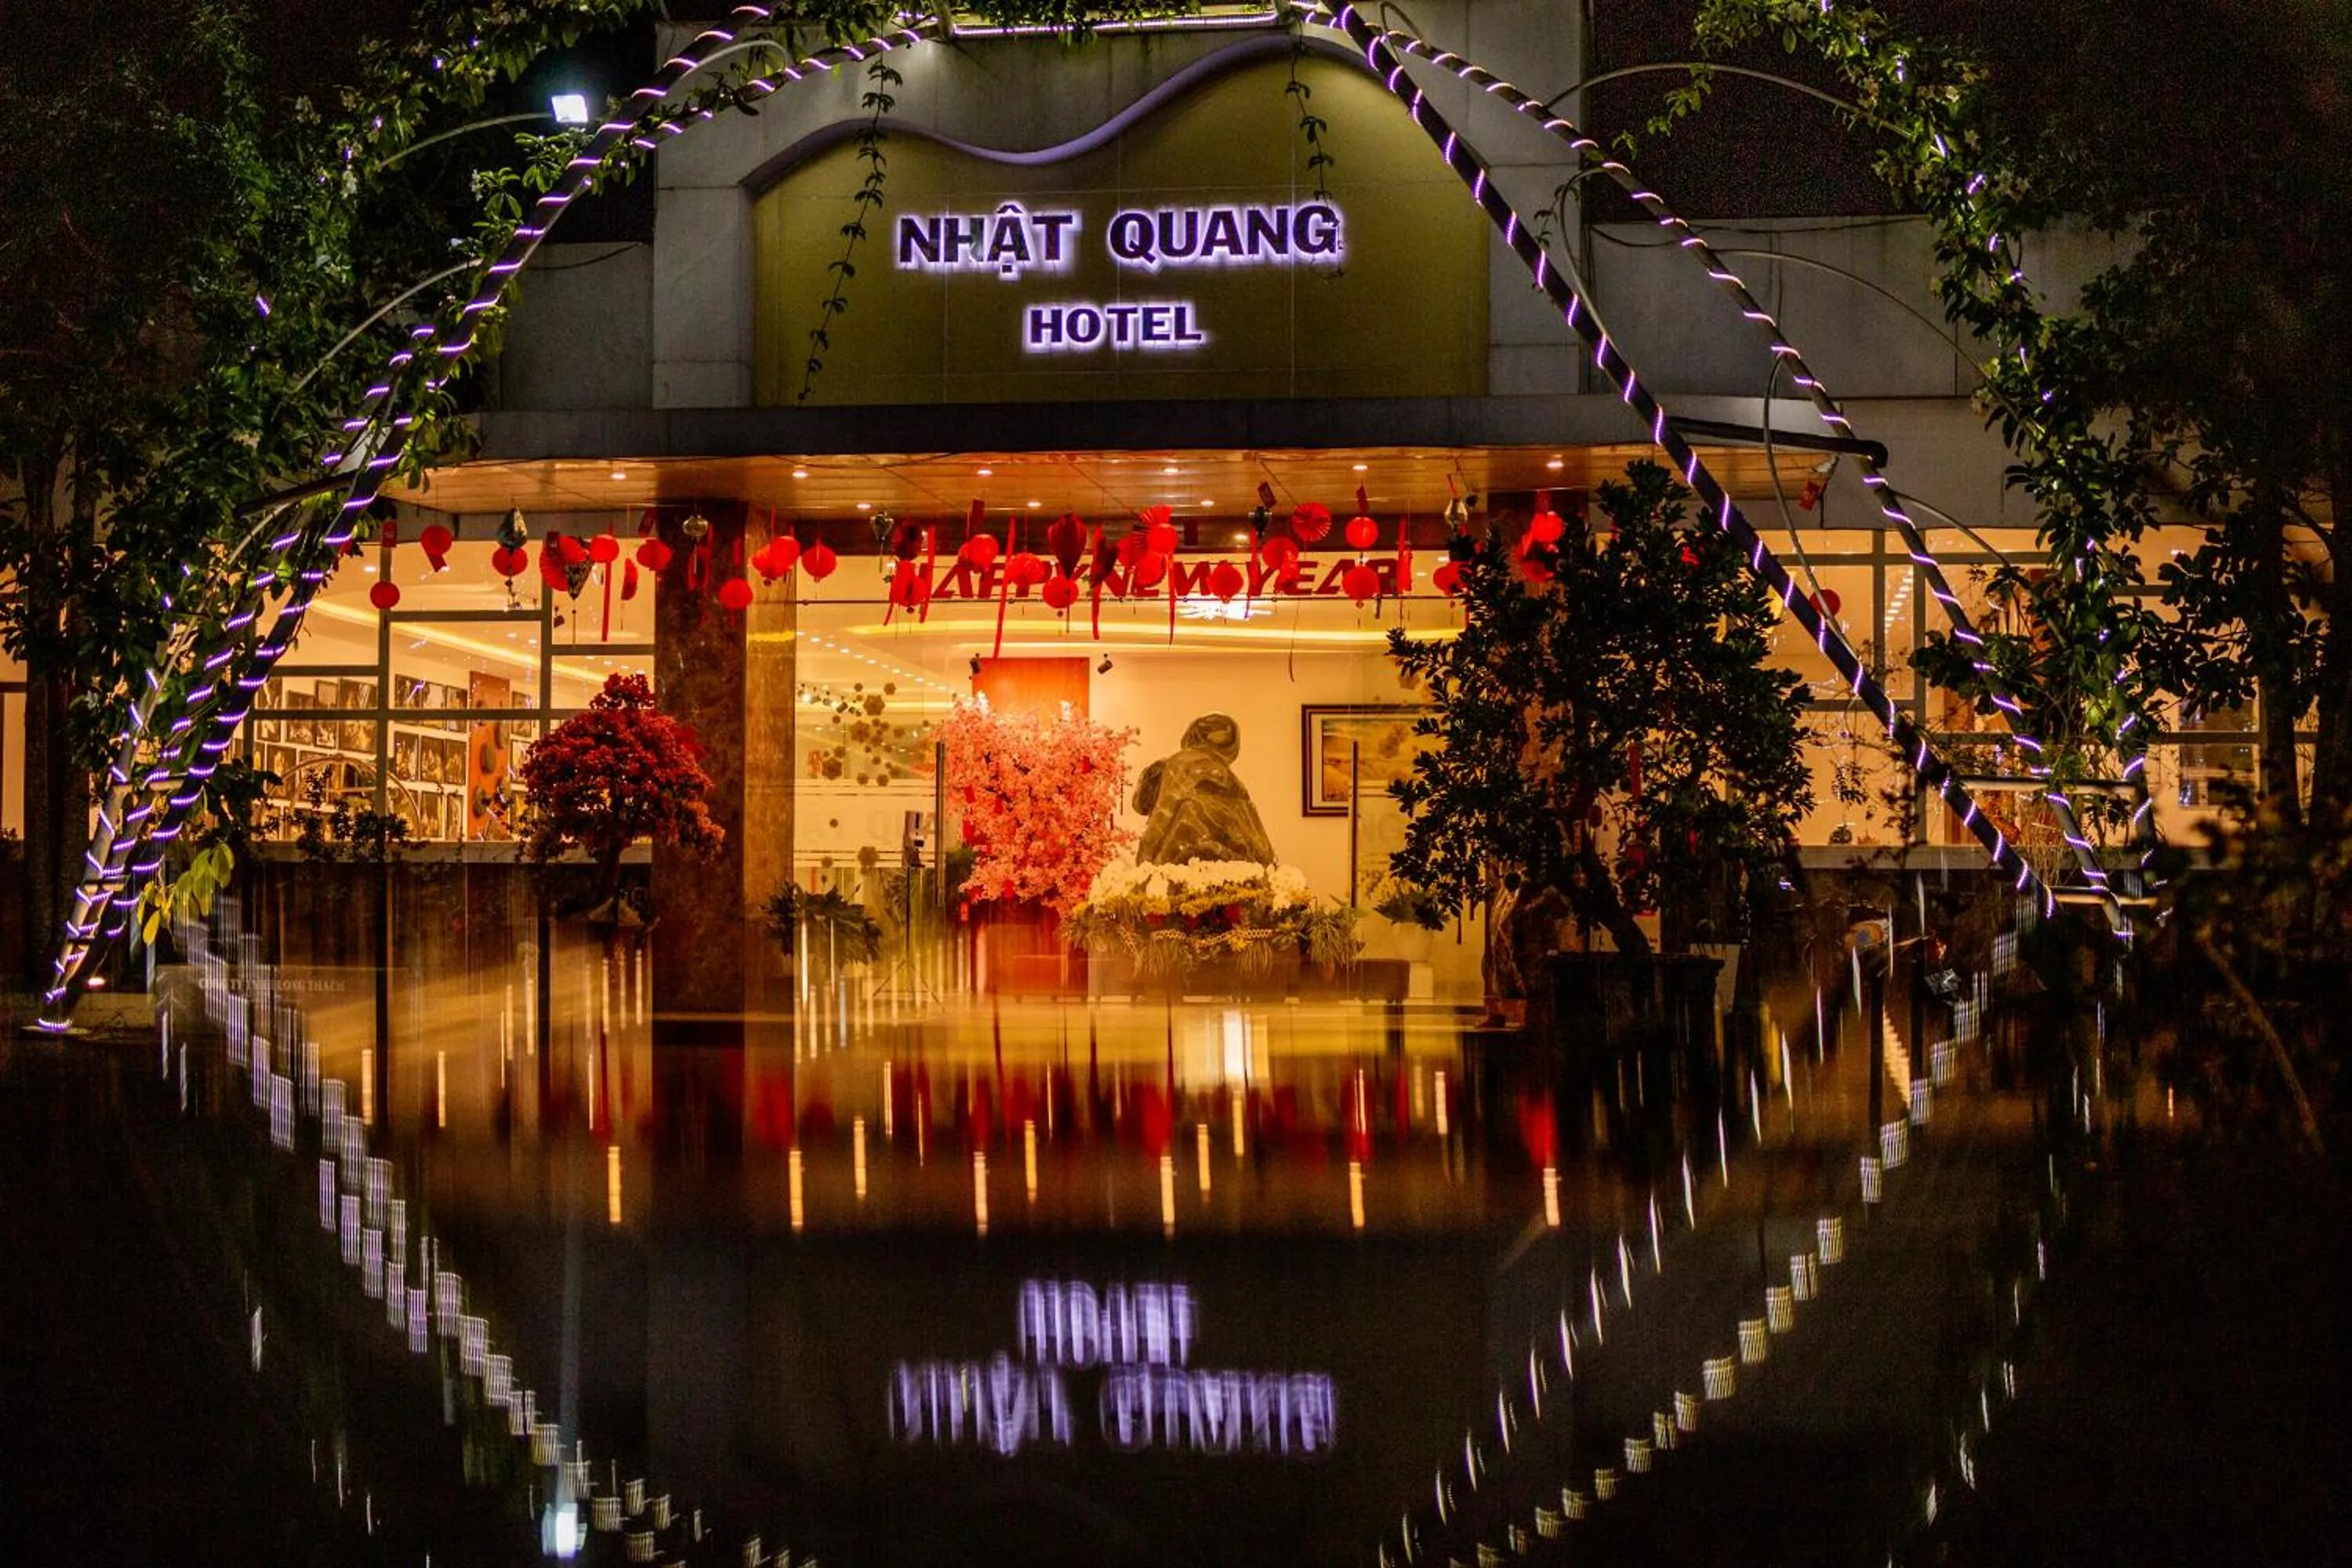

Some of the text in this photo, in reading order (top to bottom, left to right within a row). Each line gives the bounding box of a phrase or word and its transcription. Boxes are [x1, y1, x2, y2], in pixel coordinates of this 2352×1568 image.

[899, 204, 1337, 274] NHẬT QUANG
[1030, 307, 1202, 343] HOTEL
[894, 561, 1092, 598] APP
